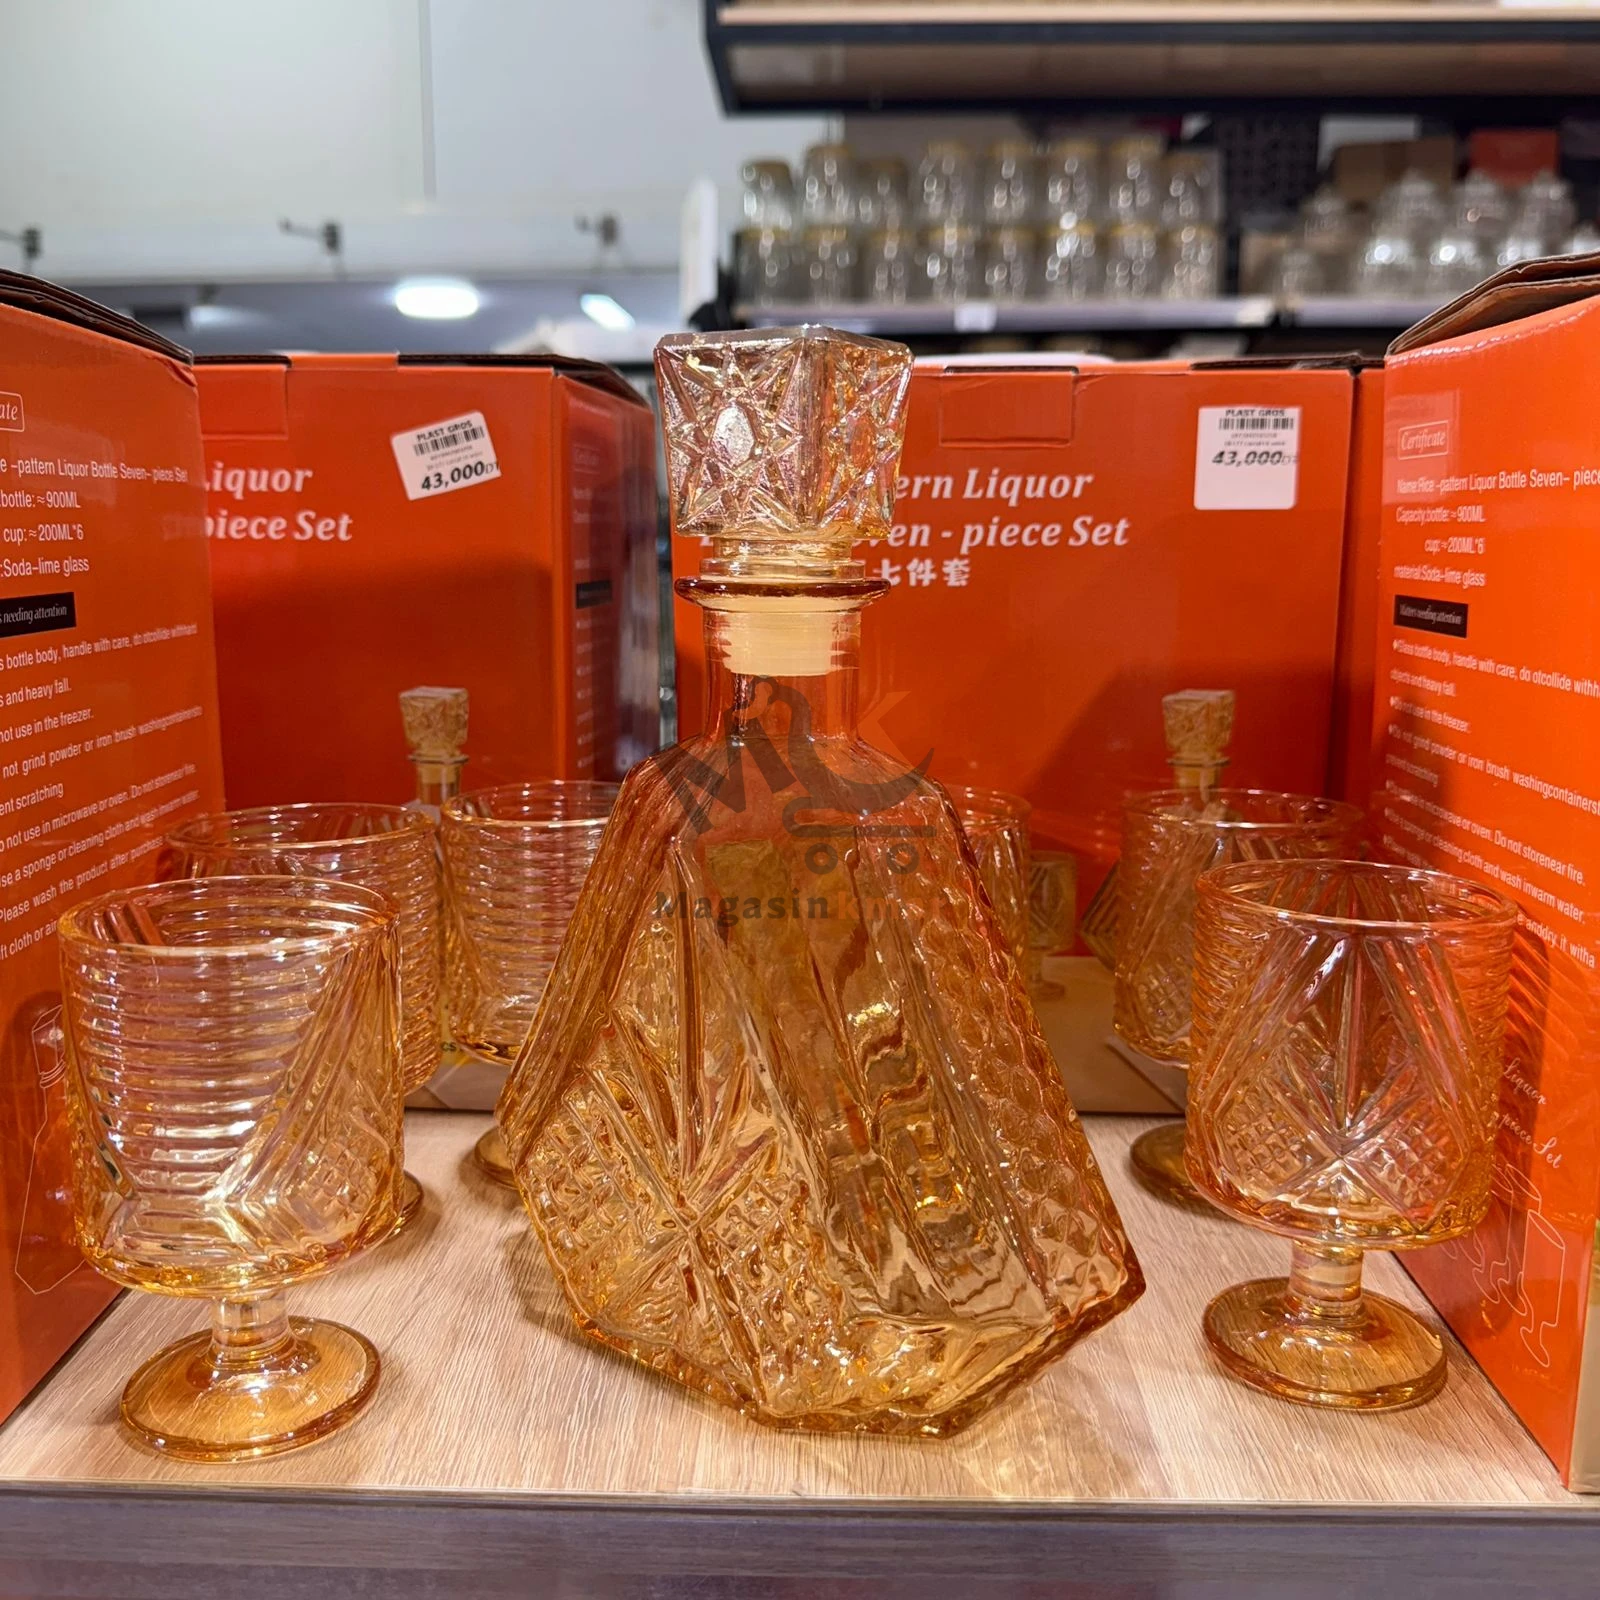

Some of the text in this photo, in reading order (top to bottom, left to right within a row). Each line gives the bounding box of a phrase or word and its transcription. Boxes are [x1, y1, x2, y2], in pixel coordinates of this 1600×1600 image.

[1401, 428, 1446, 454] Certificate
[57, 458, 89, 480] Liquor
[91, 461, 119, 480] Bottle
[152, 465, 174, 485] piece
[175, 466, 188, 483] Set
[204, 461, 313, 500] iquor
[1469, 473, 1497, 495] Liquor
[1498, 470, 1527, 489] Bottle
[962, 467, 1096, 508] Liquor
[292, 510, 353, 541] Set
[960, 515, 1064, 556] piece
[1068, 515, 1133, 547] Set
[63, 556, 90, 578] glass
[856, 558, 970, 587] 七件套
[1462, 569, 1487, 590] glass
[3, 606, 33, 625] needing
[34, 602, 68, 621] attention
[6, 650, 34, 670] bottle
[62, 639, 93, 659] handle
[93, 637, 111, 653] with
[1452, 651, 1477, 671] handle
[1477, 657, 1495, 674] with
[1519, 665, 1531, 682] do
[6, 685, 24, 706] and
[24, 684, 54, 700] heavy
[15, 723, 33, 740] use
[34, 719, 43, 735] in
[44, 715, 60, 731] the
[3, 725, 137, 779] not grind powder or iron brush
[1430, 741, 1457, 761] powder
[1457, 752, 1468, 765] or
[1467, 752, 1485, 772] iron
[1485, 759, 1511, 781] brush
[15, 782, 65, 810] scratching
[6, 830, 23, 850] not
[23, 824, 41, 843] use
[42, 819, 52, 836] in
[52, 803, 98, 831] microwave
[98, 799, 109, 812] or
[131, 784, 142, 799] Do
[0, 870, 14, 888] se
[14, 867, 22, 882] a
[22, 853, 57, 880] sponge
[57, 846, 68, 862] or
[68, 831, 105, 858] cleaning
[104, 822, 125, 841] cloth
[125, 816, 140, 832] and
[1461, 818, 1472, 831] or
[1494, 829, 1508, 848] Do
[1507, 838, 1522, 856] not
[33, 883, 57, 908] wash
[59, 878, 75, 896] the
[76, 860, 109, 889] product
[110, 852, 129, 870] after
[129, 835, 164, 862] purchase
[1432, 835, 1464, 864] cleaning
[1463, 849, 1484, 870] cloth
[1483, 860, 1500, 880] and
[1499, 869, 1522, 890] wash
[9, 932, 33, 956] cloth
[34, 926, 44, 943] or
[1559, 933, 1568, 953] it
[1503, 1056, 1547, 1105] Liquor
[1498, 1113, 1563, 1169] piece Set
